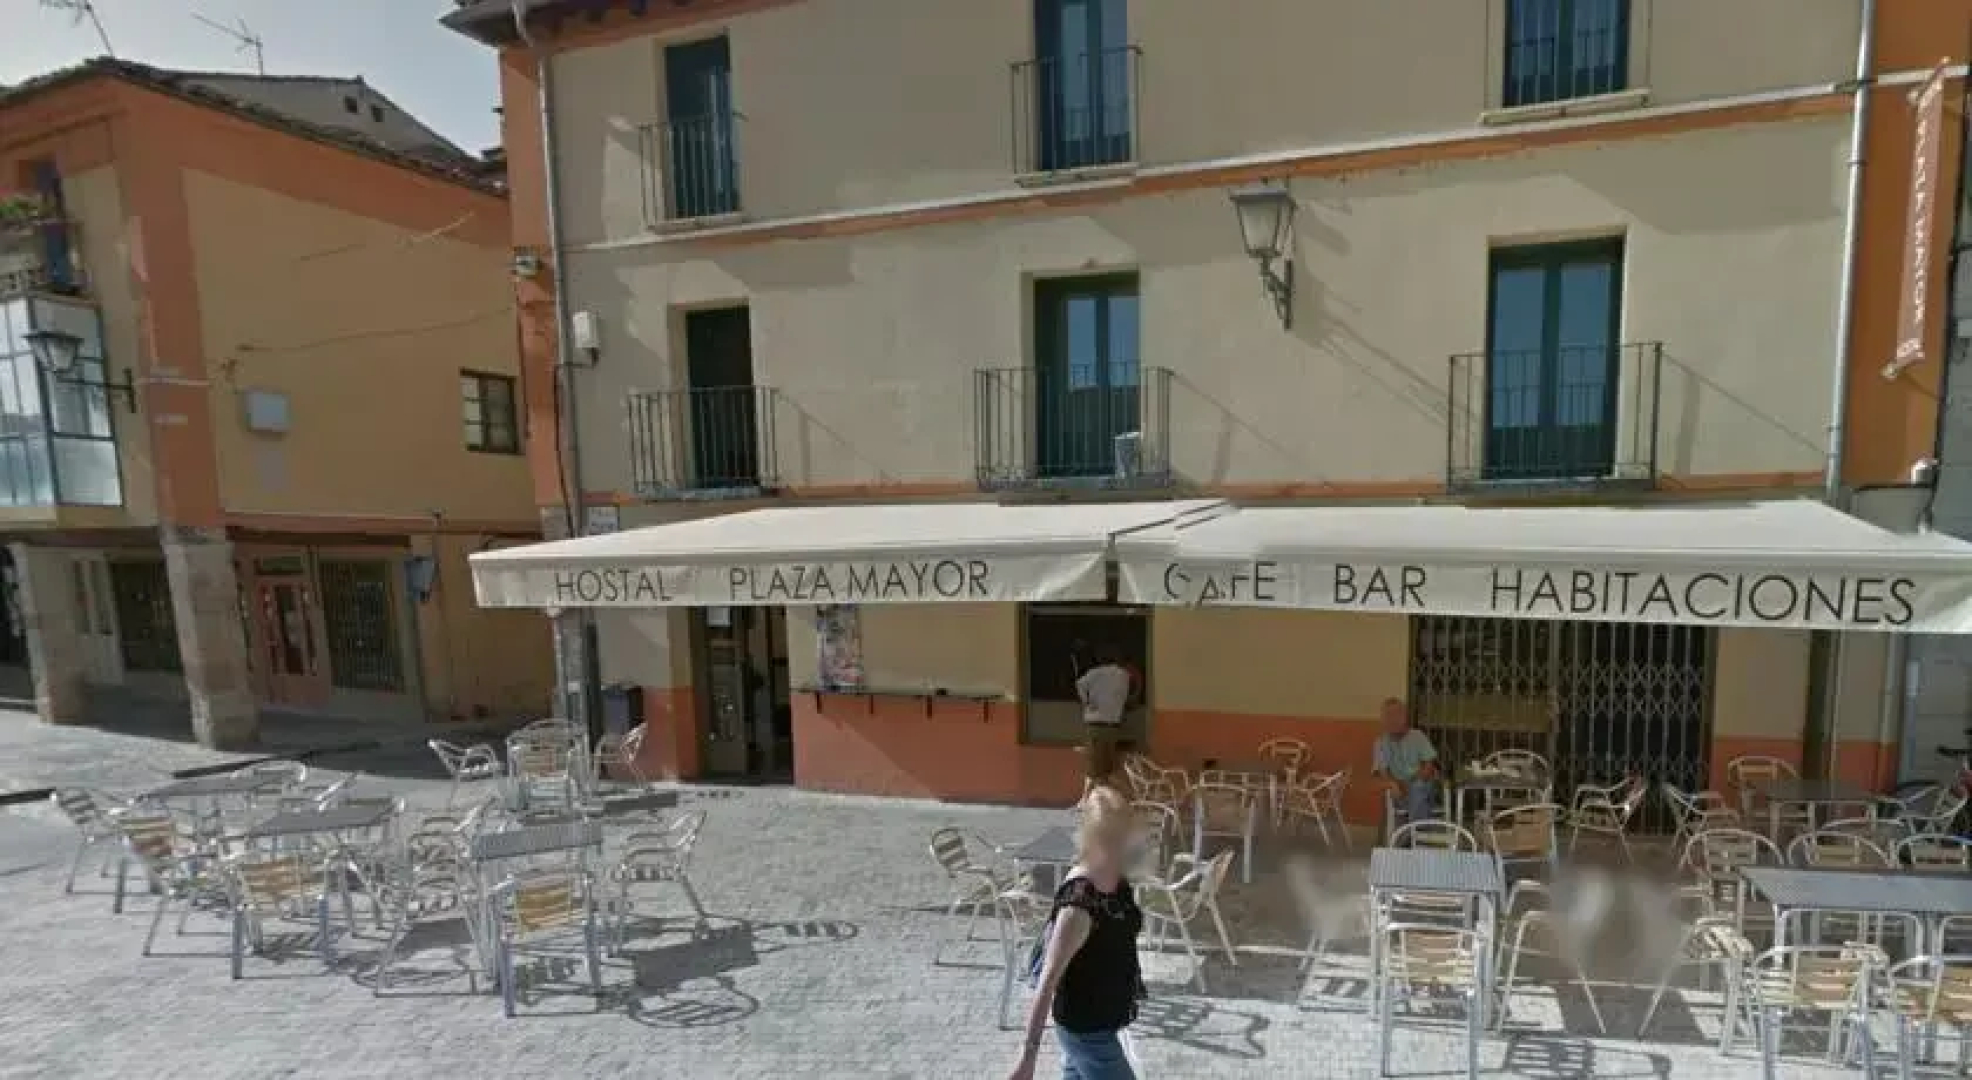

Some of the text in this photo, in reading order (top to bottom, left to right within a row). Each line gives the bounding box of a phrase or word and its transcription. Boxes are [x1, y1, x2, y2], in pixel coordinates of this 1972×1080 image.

[555, 560, 989, 602] HOSTAL PLAZA MAYOR
[1333, 564, 1426, 607] BAR
[1490, 567, 1917, 625] HABITACIONES
